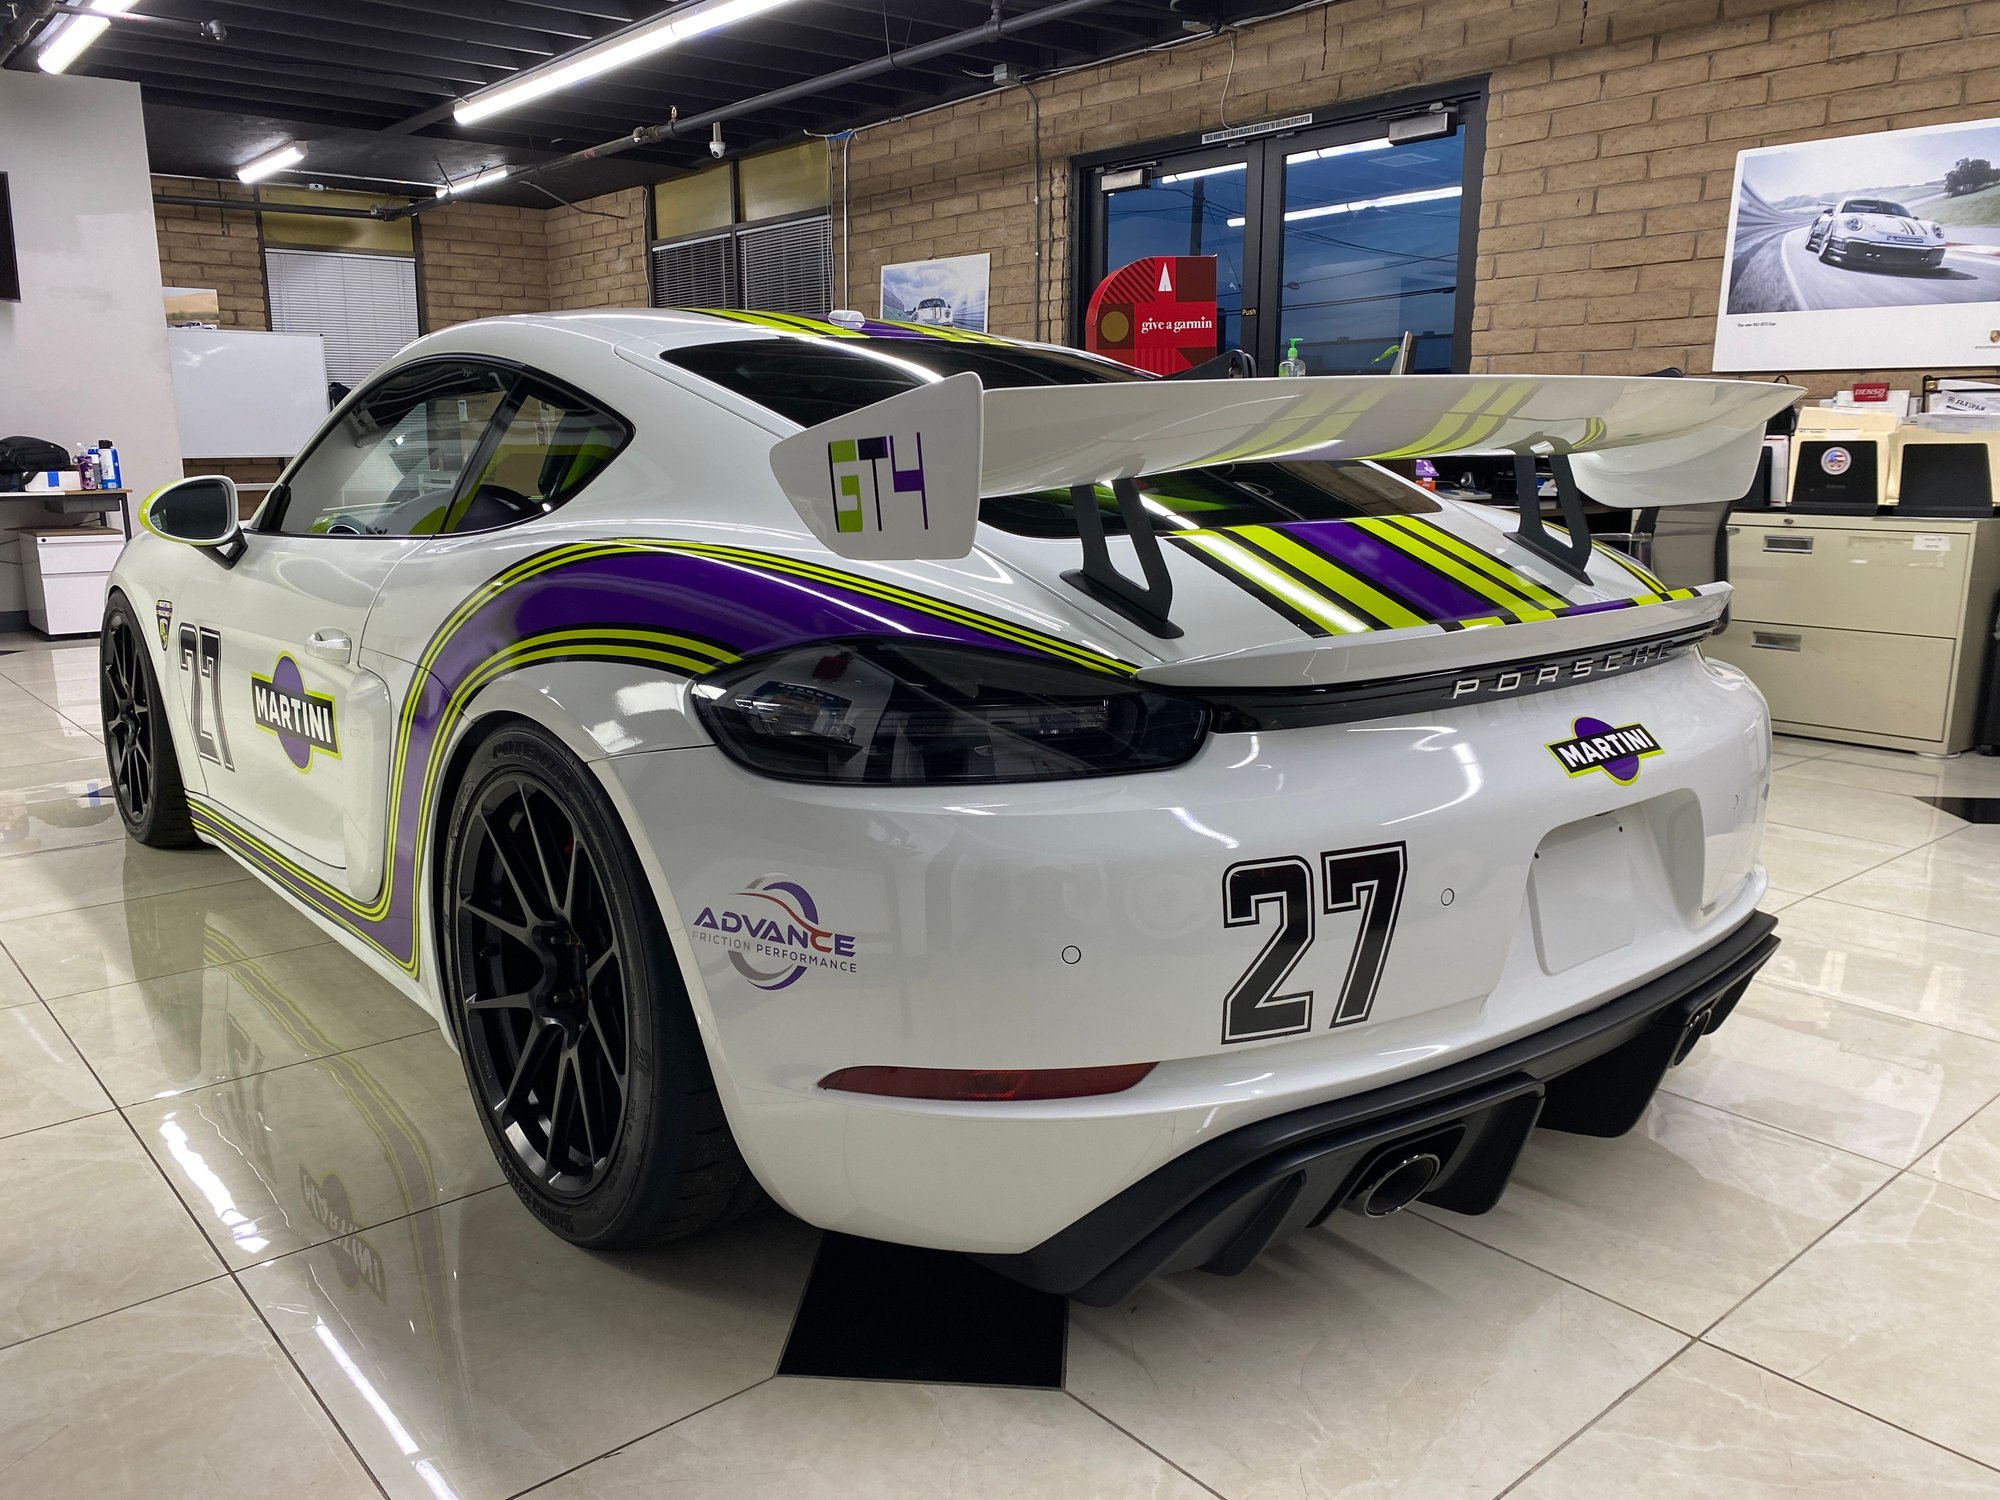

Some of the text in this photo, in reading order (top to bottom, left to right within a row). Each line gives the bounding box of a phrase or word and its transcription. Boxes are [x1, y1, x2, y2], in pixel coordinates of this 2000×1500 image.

[1141, 317, 1165, 334] give
[1173, 316, 1212, 333] garmin
[1241, 308, 1257, 316] Push
[1854, 387, 1886, 397] DENSO
[828, 432, 929, 533] GT4
[1450, 641, 1675, 700] PORSCHE
[178, 622, 236, 773] 27
[254, 685, 332, 744] MARTINI
[1557, 727, 1655, 769] MARTINI
[692, 931, 857, 973] FRICTION PERFORMANCE
[693, 906, 856, 958] ADVANCE
[1221, 840, 1409, 1045] 27
